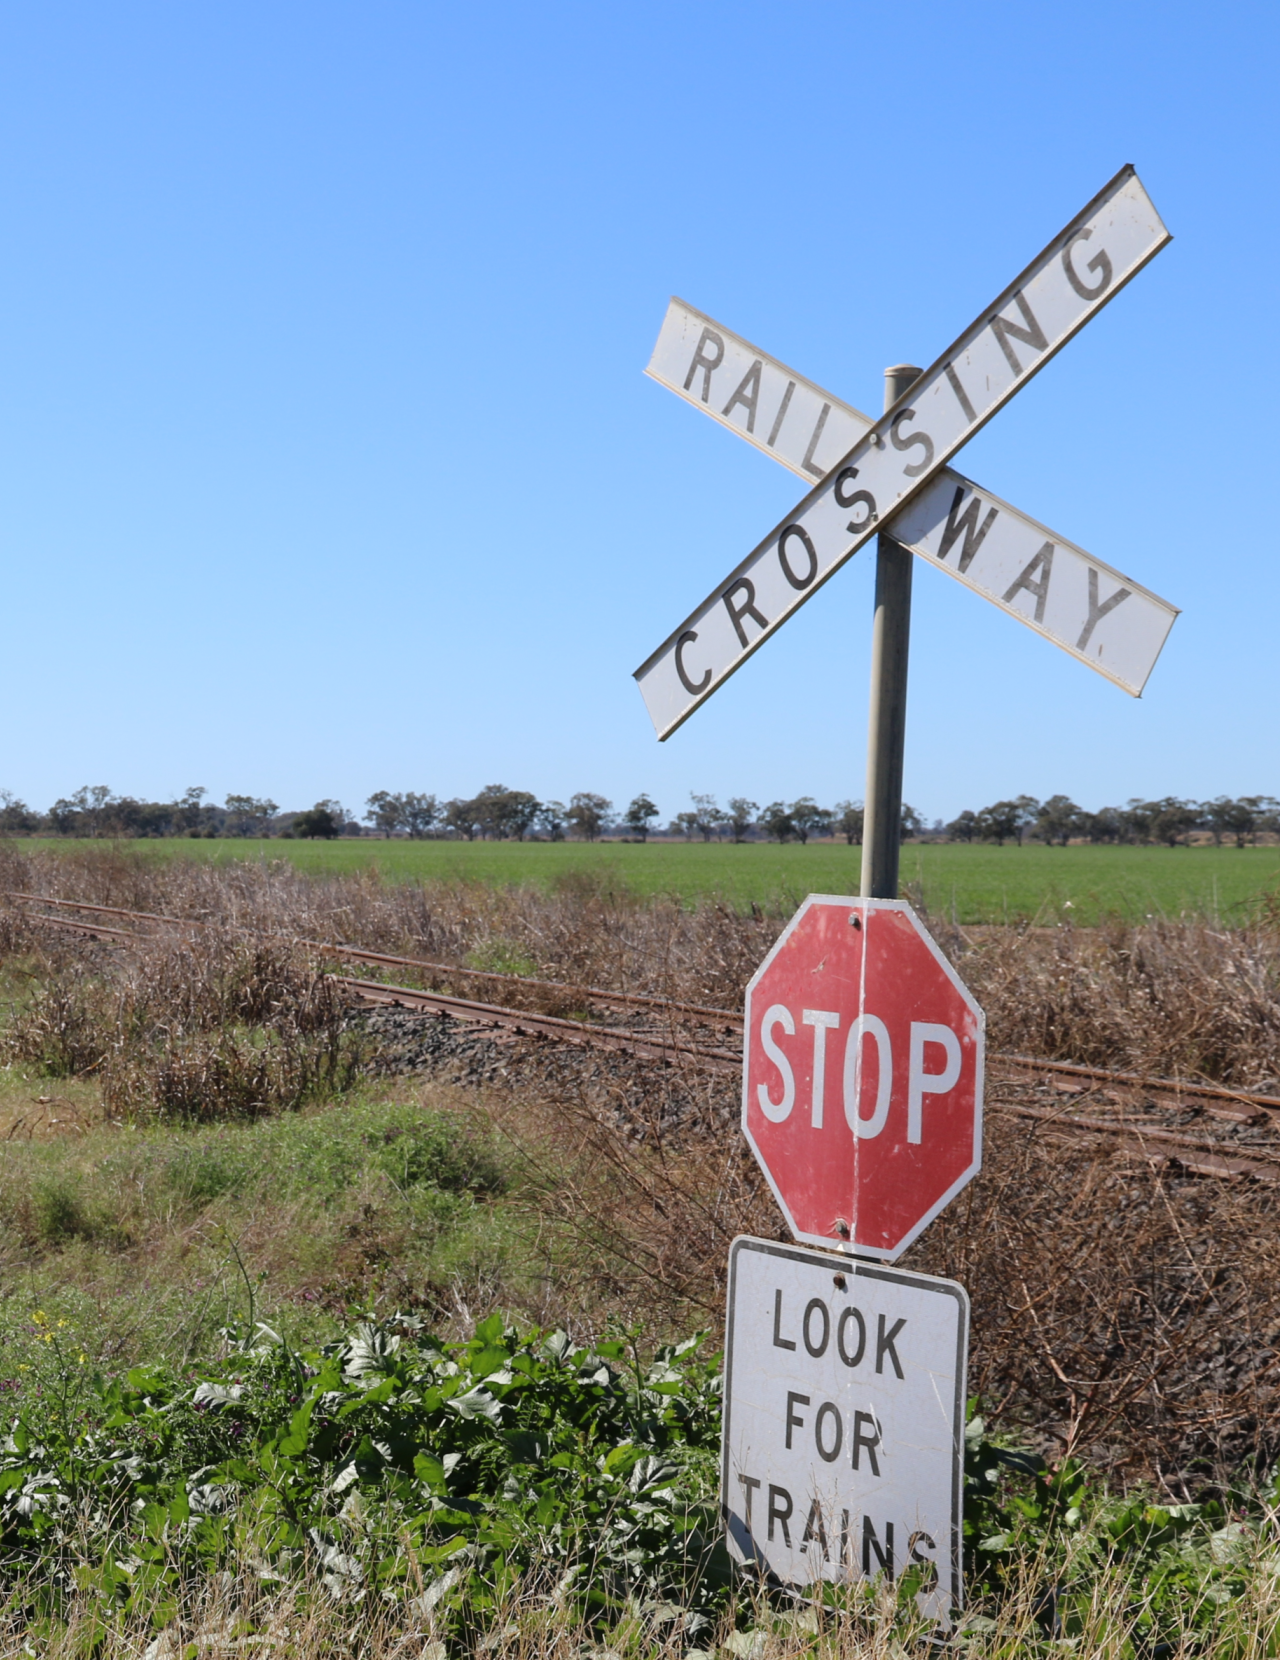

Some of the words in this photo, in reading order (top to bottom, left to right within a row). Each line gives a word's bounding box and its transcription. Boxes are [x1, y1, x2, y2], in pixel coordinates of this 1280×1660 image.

[675, 227, 1114, 696] CROSSING
[684, 326, 828, 479] RAIL
[937, 486, 1132, 652] WAY
[757, 1004, 962, 1144] STOP
[773, 1289, 908, 1380] LOOK
[785, 1390, 883, 1477] FOR
[738, 1473, 939, 1593] TRAINS
